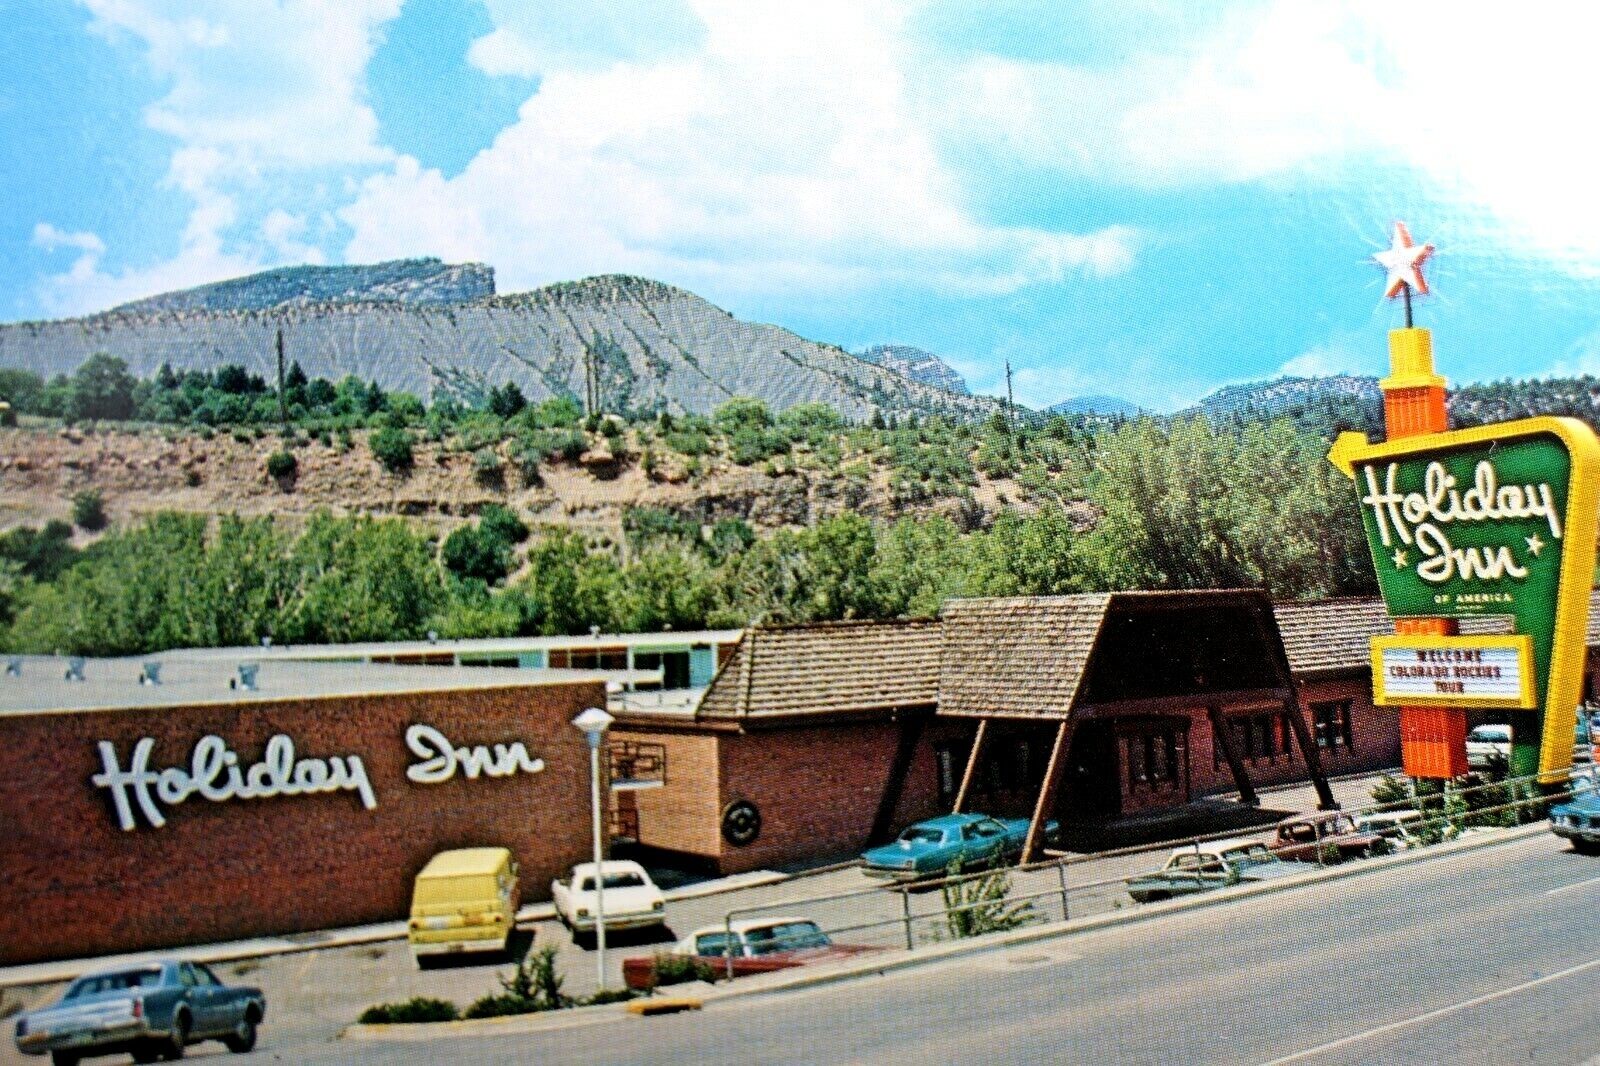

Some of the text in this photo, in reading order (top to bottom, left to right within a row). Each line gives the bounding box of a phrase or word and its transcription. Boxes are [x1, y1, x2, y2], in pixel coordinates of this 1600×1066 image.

[1363, 460, 1563, 547] Holiday
[1415, 522, 1528, 582] Inn
[1434, 593, 1514, 604] OF AMERICA
[1416, 649, 1482, 662] WELCOME
[1390, 665, 1501, 678] COLORADO ROCKIES
[1434, 681, 1464, 693] TOUR
[92, 724, 545, 831] Holiday Inn
